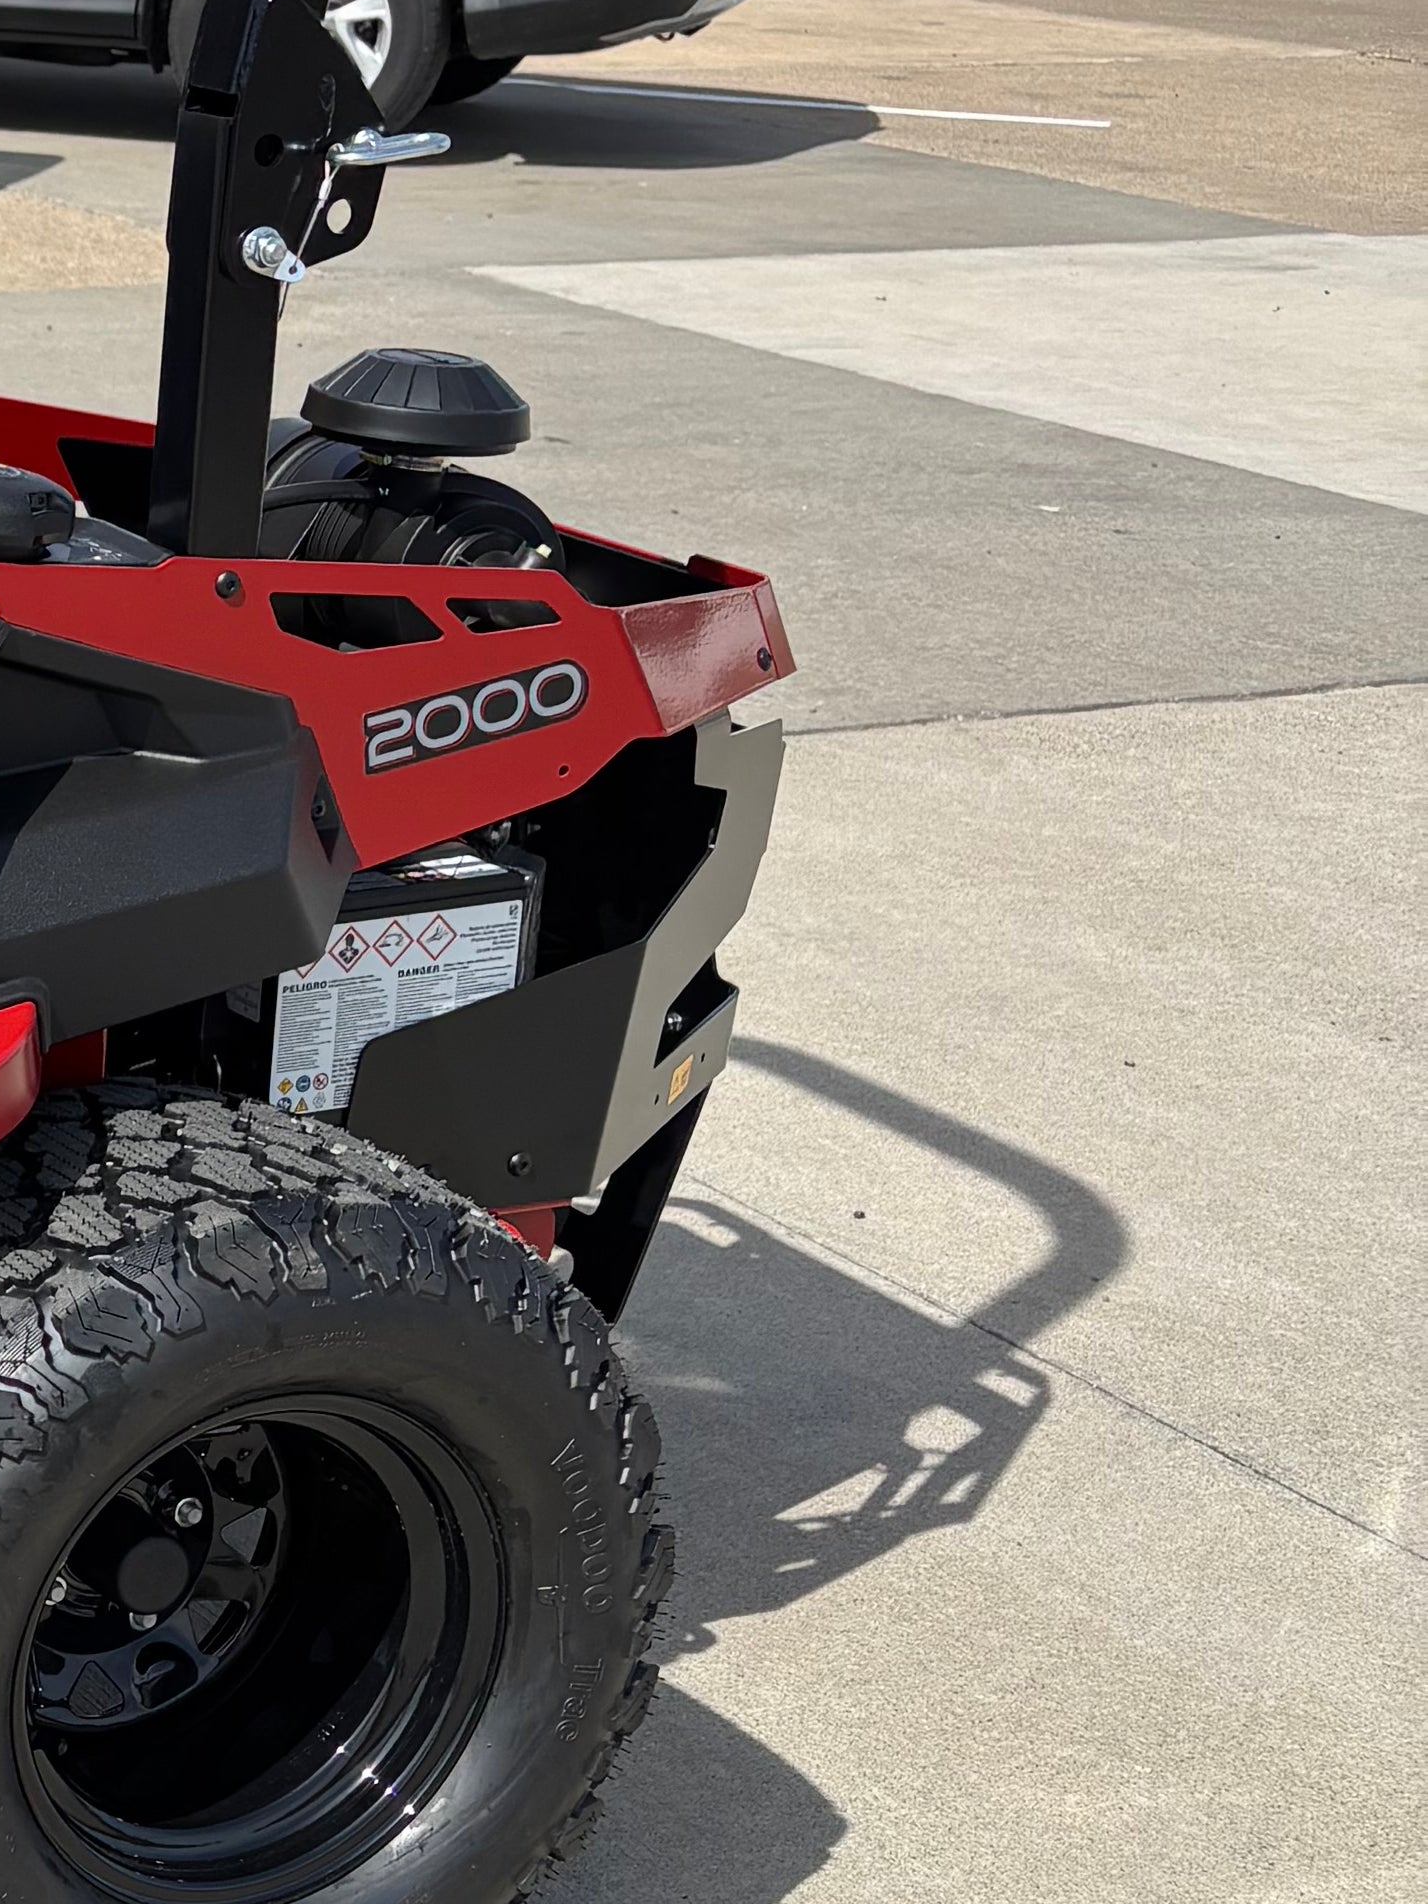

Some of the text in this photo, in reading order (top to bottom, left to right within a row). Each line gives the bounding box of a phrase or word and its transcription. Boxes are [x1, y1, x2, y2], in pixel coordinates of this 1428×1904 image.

[366, 663, 584, 770] 2000
[282, 980, 328, 994] PELIGRO
[553, 1657, 606, 1744] Trac
